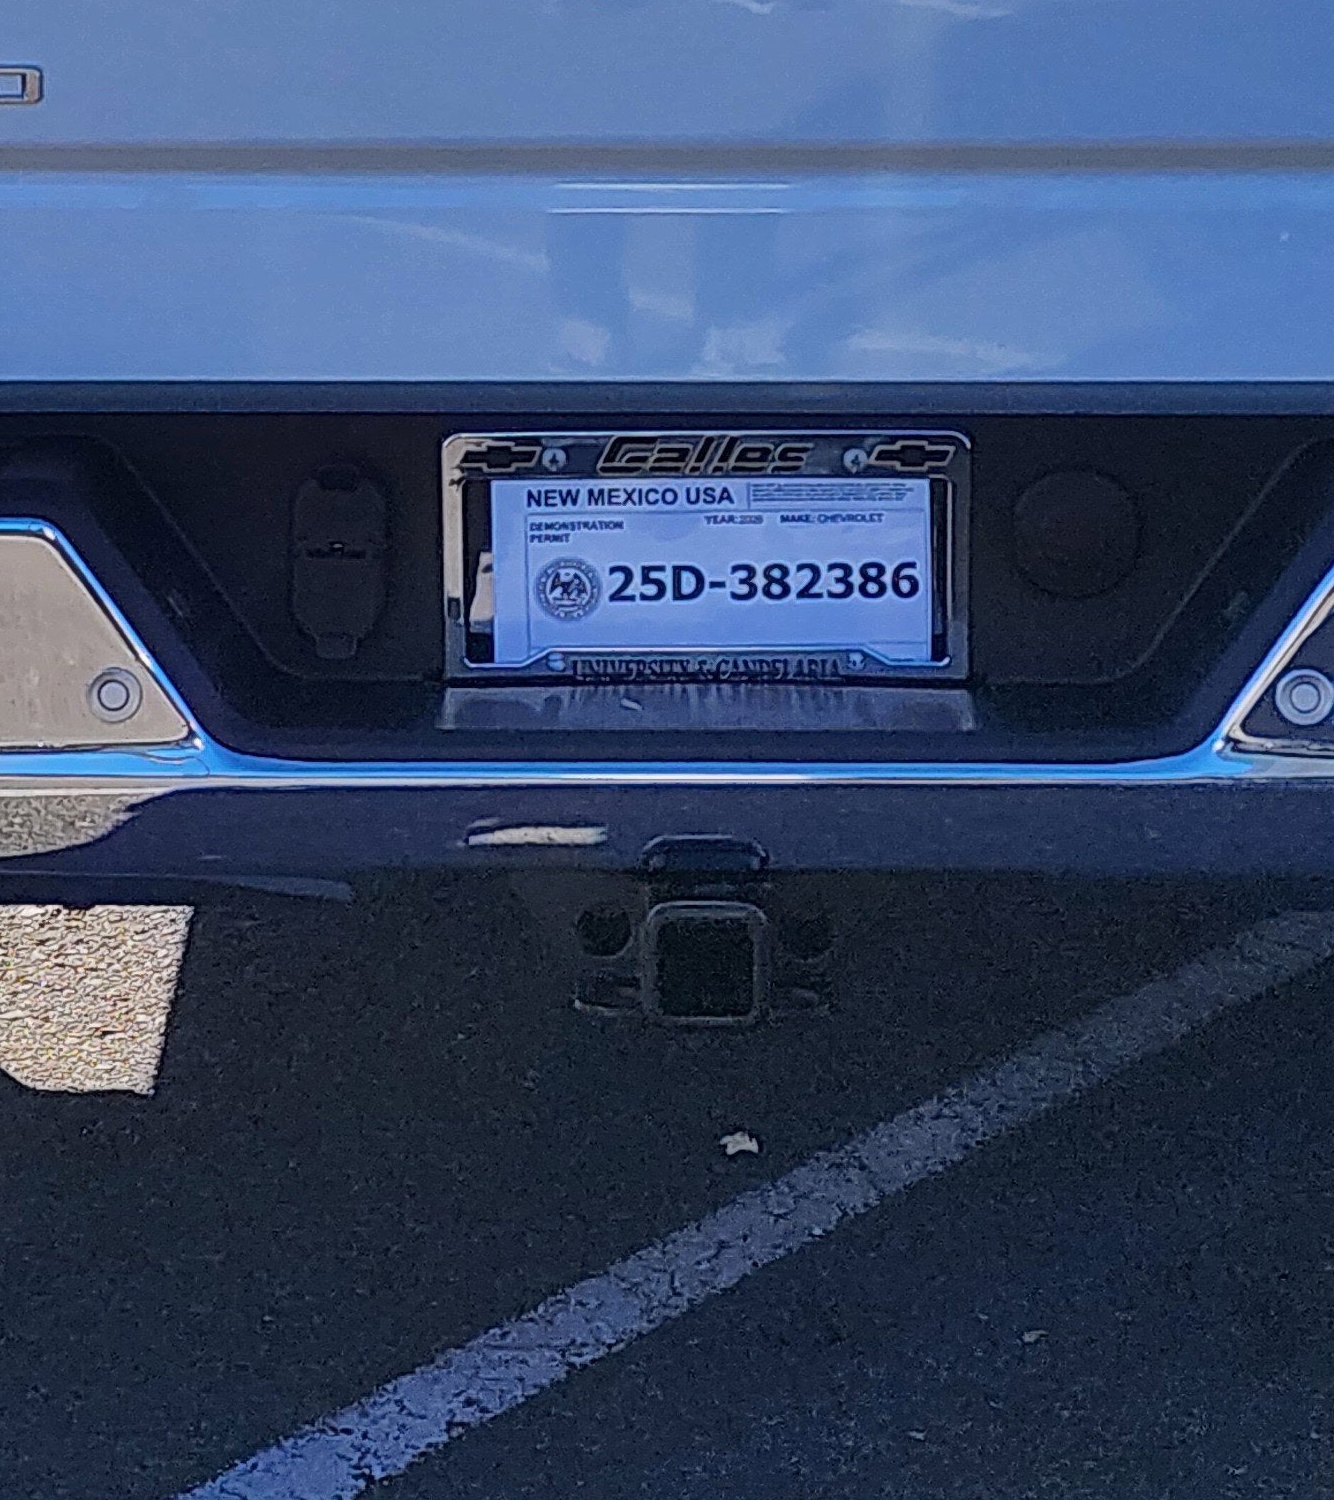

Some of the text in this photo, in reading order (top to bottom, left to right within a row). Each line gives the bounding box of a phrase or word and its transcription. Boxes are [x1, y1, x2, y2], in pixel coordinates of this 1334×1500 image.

[595, 435, 815, 476] Galles
[526, 488, 581, 508] NEW
[587, 486, 679, 507] MEXICO
[685, 486, 735, 506] USA
[528, 520, 625, 532] DEMONSTRATION
[816, 512, 885, 524] CHEVROLET
[528, 533, 571, 544] PERMIT
[607, 561, 920, 602] 25D-382386
